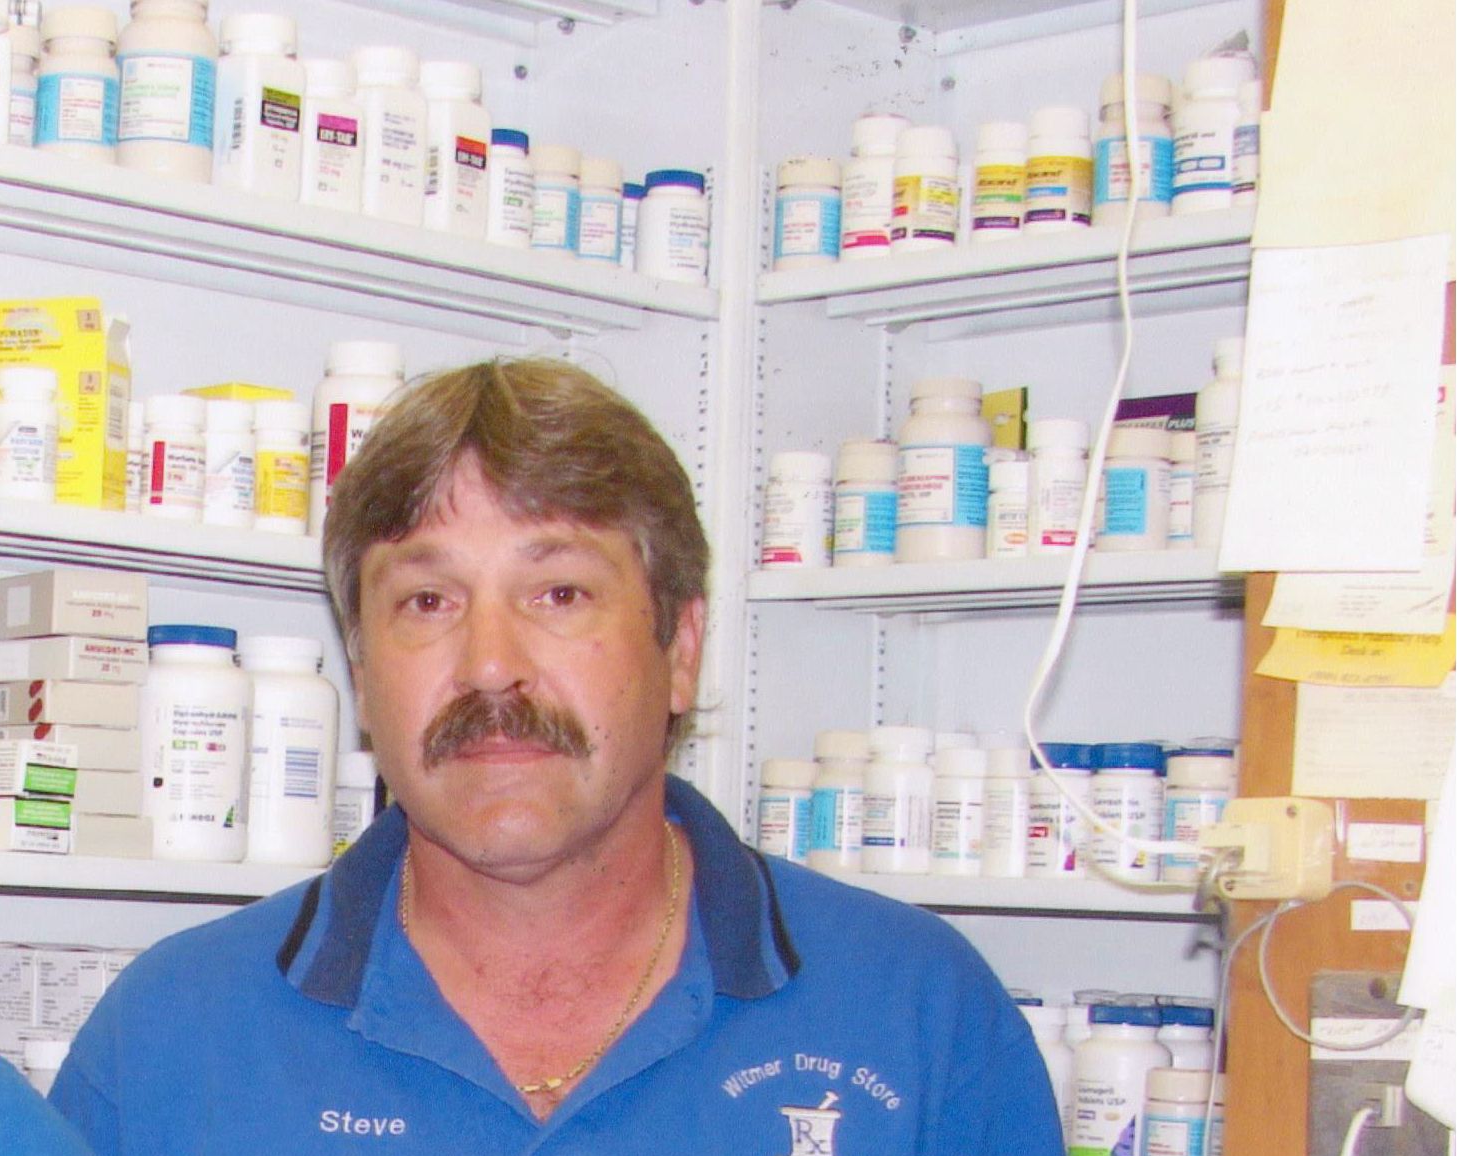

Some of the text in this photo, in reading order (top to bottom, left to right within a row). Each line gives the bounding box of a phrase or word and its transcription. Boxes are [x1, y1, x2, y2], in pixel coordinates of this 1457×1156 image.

[1168, 418, 1195, 430] PLUS
[721, 1053, 902, 1111] Witmer Drug Store
[319, 1110, 406, 1136] Steve
